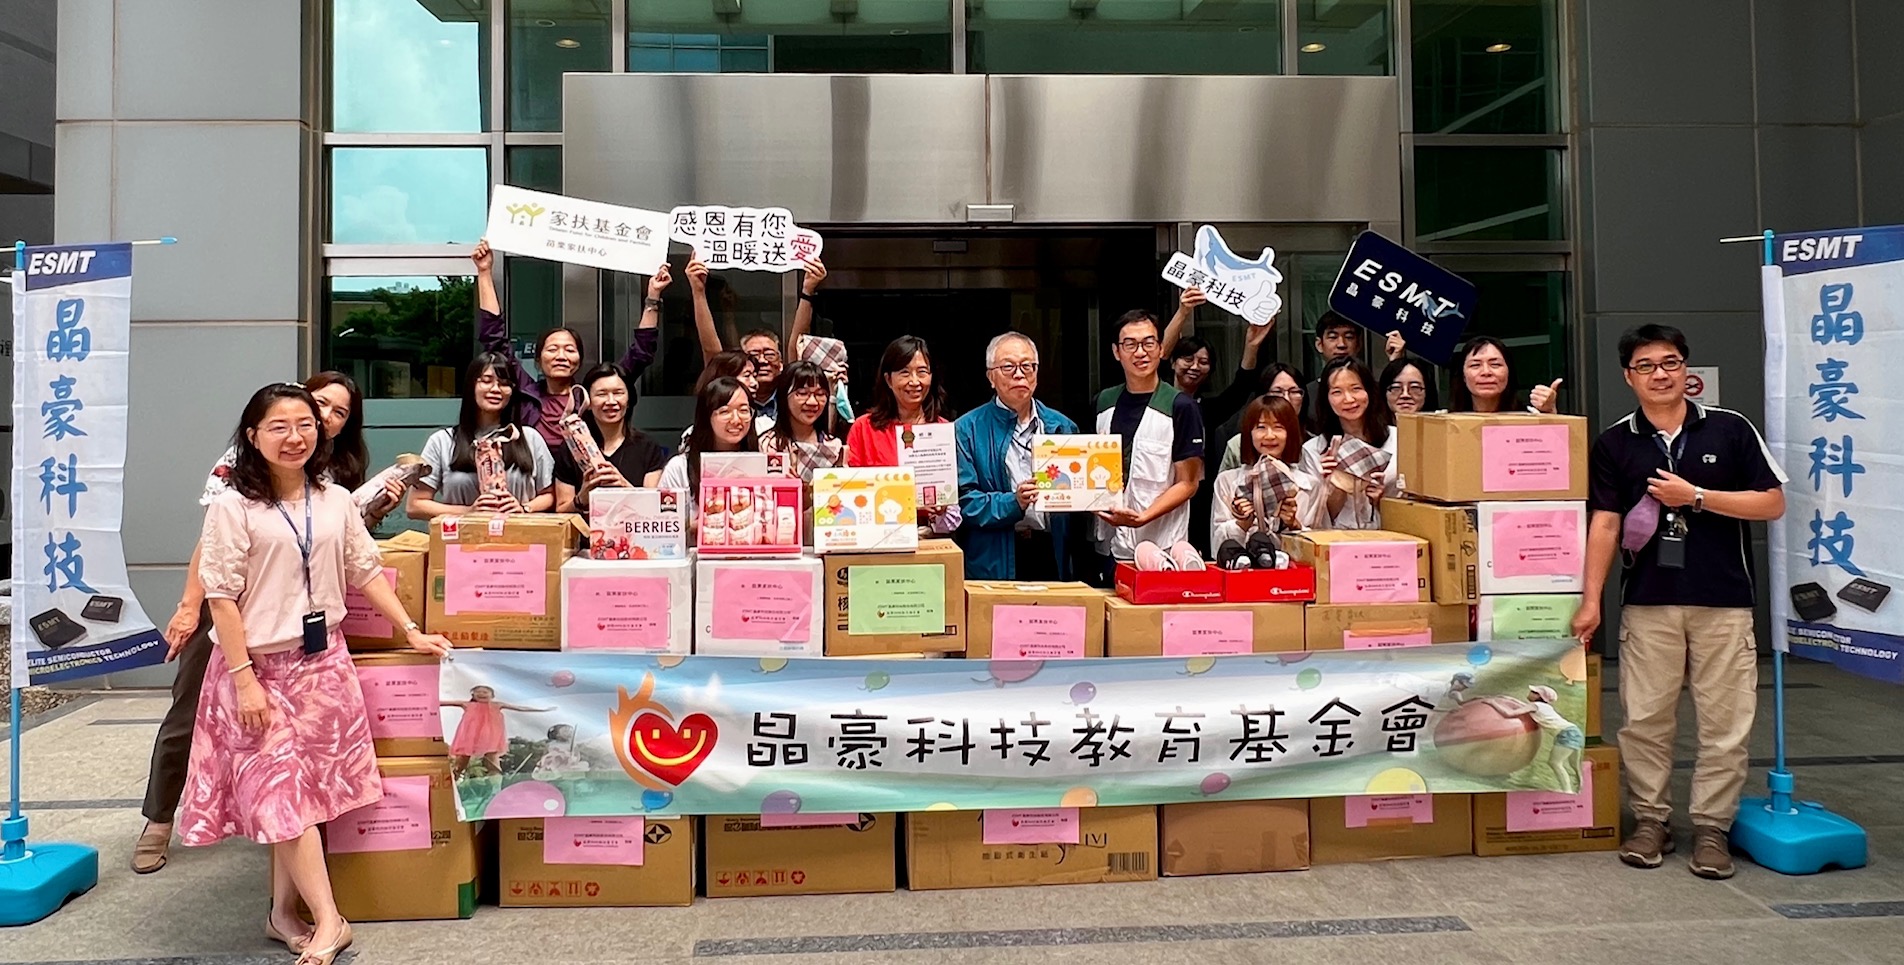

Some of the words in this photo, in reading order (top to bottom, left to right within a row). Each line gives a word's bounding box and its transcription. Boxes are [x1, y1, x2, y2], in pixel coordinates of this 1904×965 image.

[550, 210, 652, 241] 家扶基金會
[673, 210, 787, 240] 感恩有您
[703, 234, 817, 267] 溫暖送愛
[1782, 234, 1863, 263] ESMT
[27, 250, 96, 277] ESMT
[1231, 272, 1257, 282] ESMT
[1167, 260, 1247, 310] 晶豪科技
[1353, 258, 1457, 318] ESMT
[1345, 282, 1435, 337] 晶豪科技
[1807, 282, 1868, 578] 晶豪科技
[39, 297, 101, 595] 晶豪科技
[625, 520, 680, 533] BERRIES
[89, 600, 114, 610] ESMT
[1181, 590, 1221, 599] Champion
[1270, 586, 1310, 597] Champion
[103, 639, 159, 662] TECHNOLOGY
[1839, 644, 1898, 661] TECHNOLOGY
[747, 695, 1438, 768] 晶豪科技教育基金會
